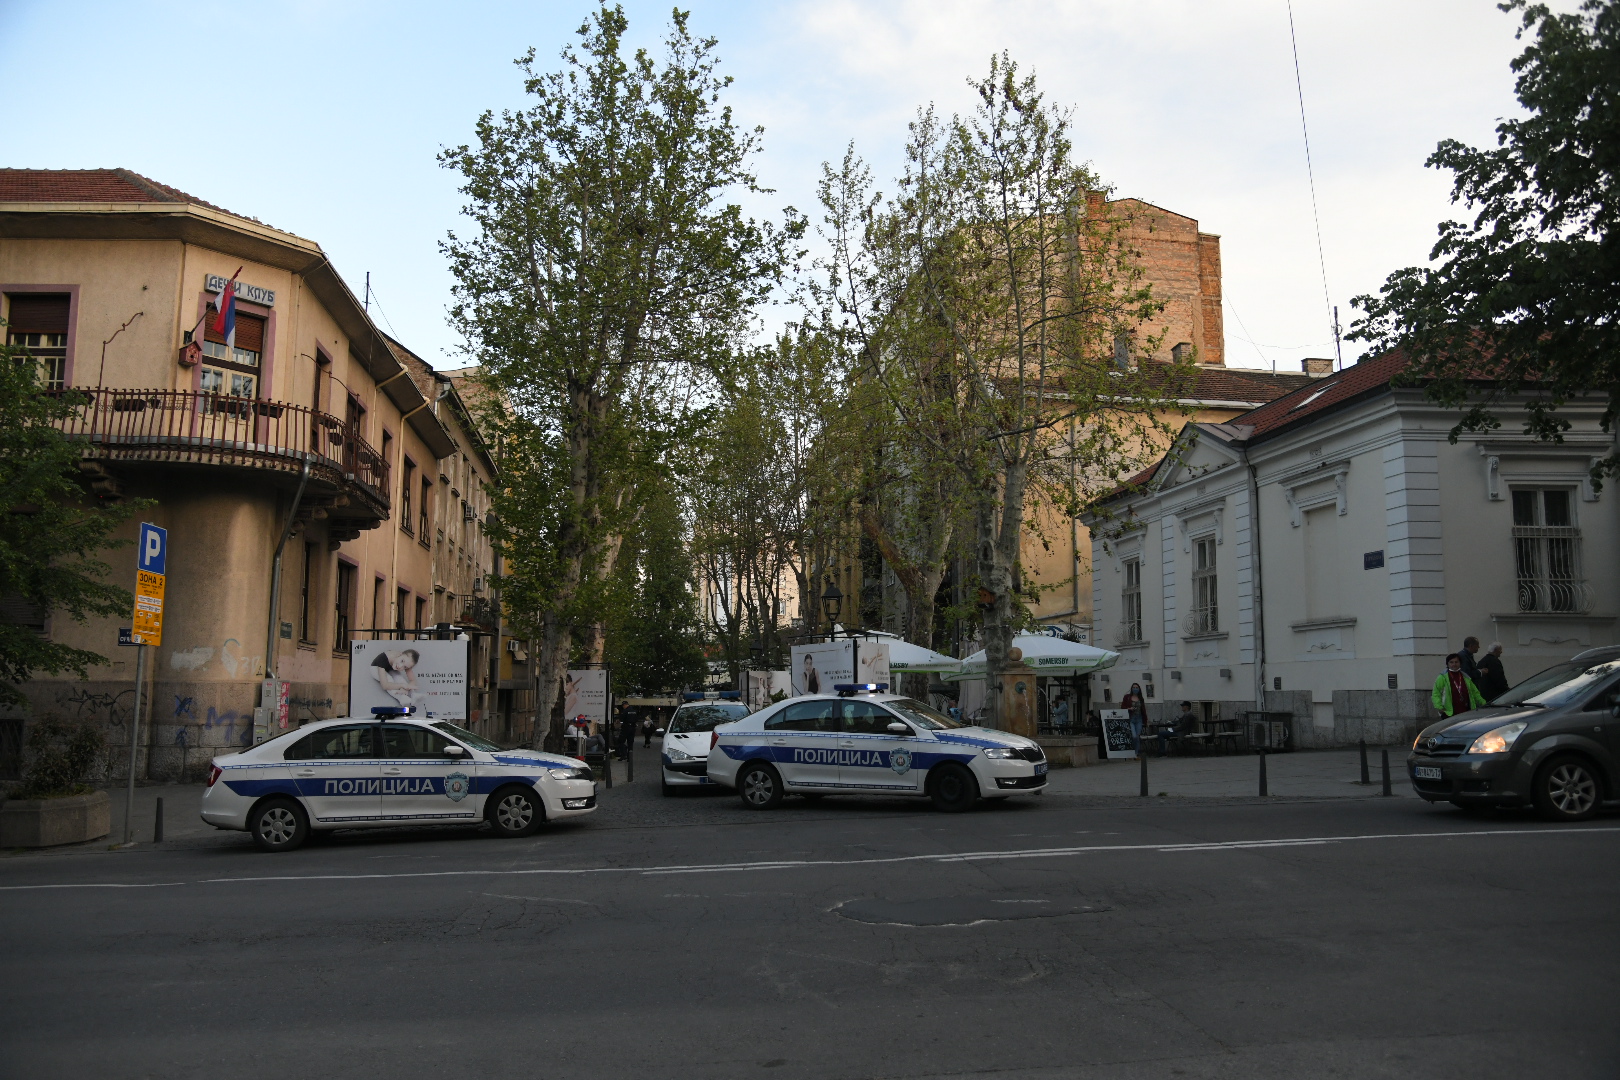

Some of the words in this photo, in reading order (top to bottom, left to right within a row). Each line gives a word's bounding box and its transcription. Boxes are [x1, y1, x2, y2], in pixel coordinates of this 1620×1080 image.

[208, 276, 241, 294] ДЕЧИ
[247, 285, 275, 303] КЛУБ
[145, 530, 161, 566] P
[139, 573, 157, 585] ЗОНА
[159, 577, 164, 587] 2
[1038, 657, 1069, 666] SOMERSBY
[794, 749, 883, 766] ПОЛИЦИЈА
[324, 779, 435, 795] ПОЛИЦИЈА
